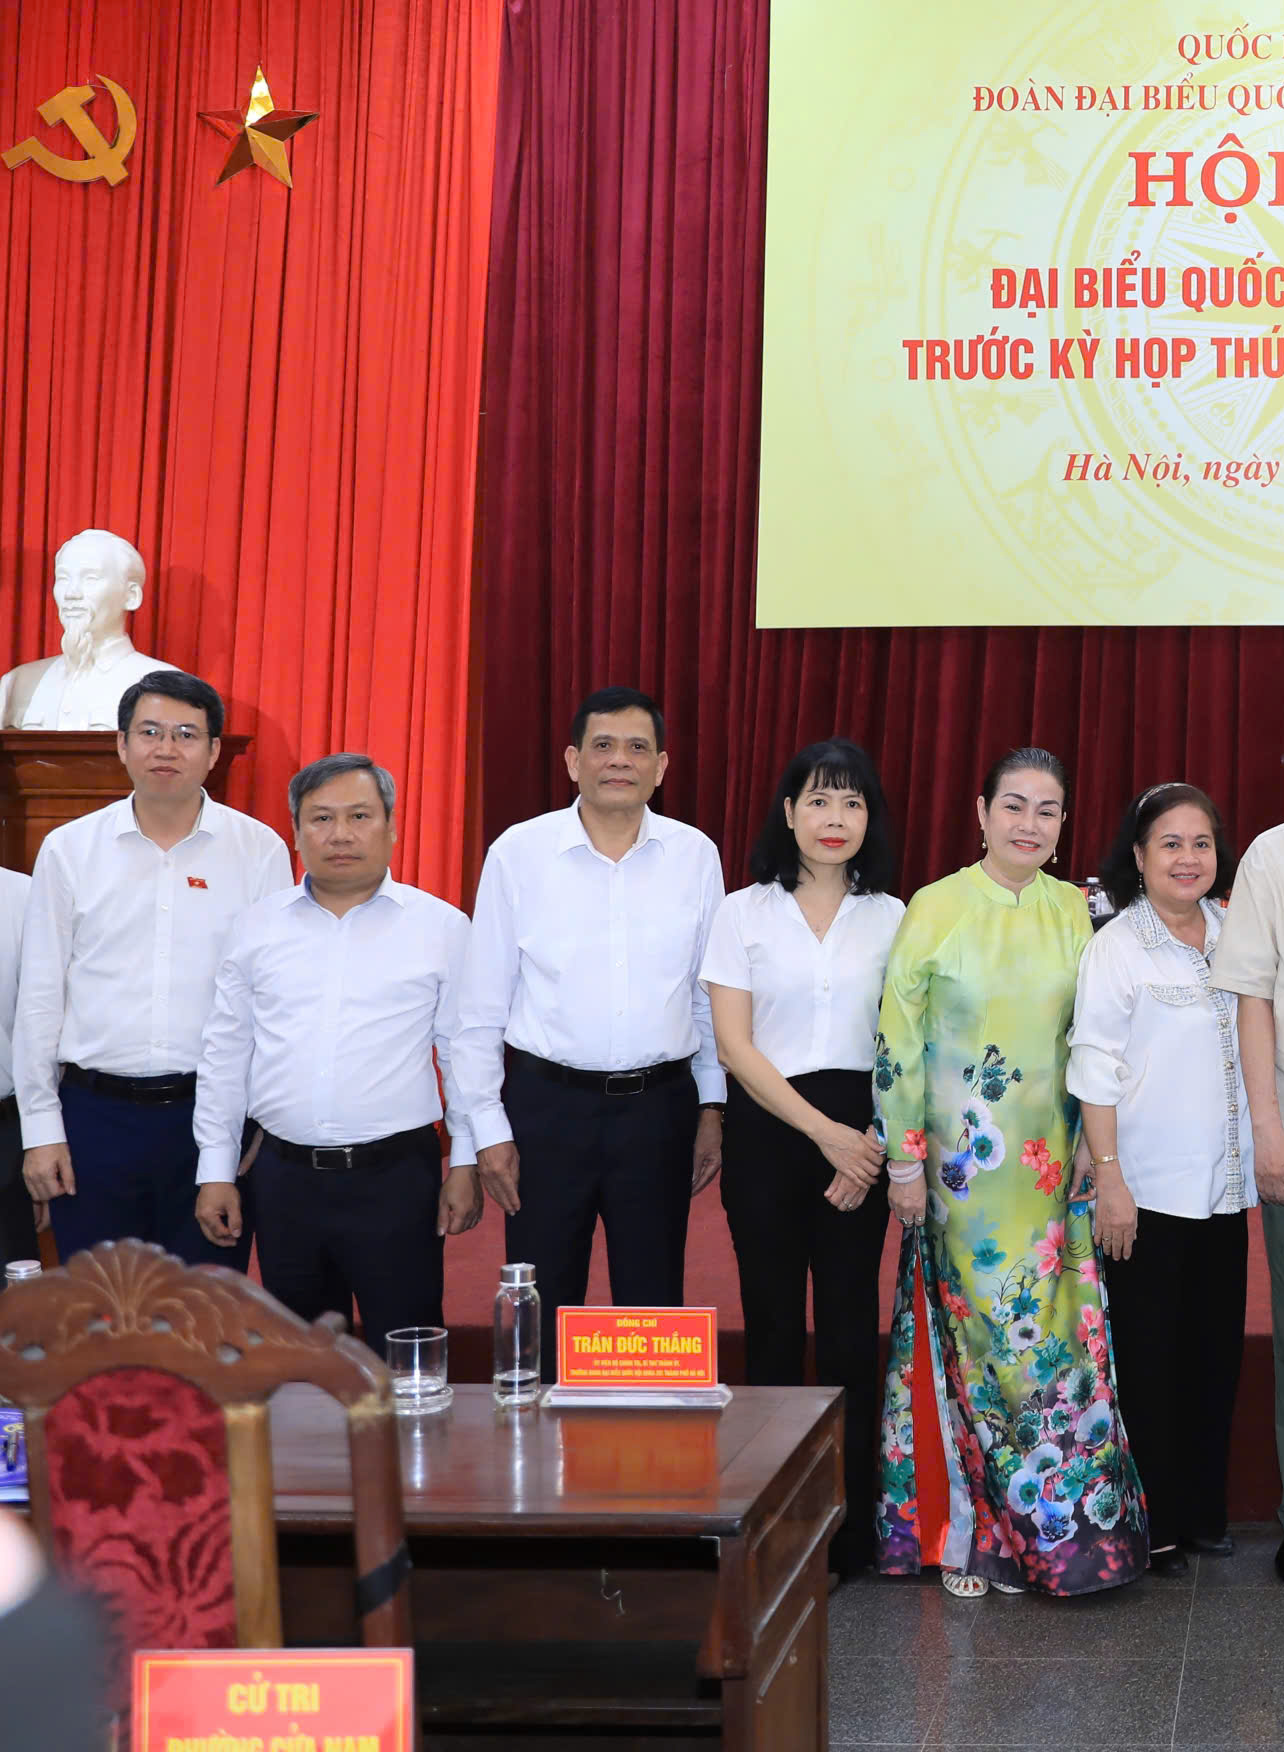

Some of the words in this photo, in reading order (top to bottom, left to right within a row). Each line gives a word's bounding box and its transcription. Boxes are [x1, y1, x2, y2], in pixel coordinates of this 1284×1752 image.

[1178, 24, 1272, 65] QUỐC
[973, 78, 1065, 112] ĐOÀN
[1075, 85, 1132, 117] ĐẠI
[1142, 72, 1218, 111] BIỂU
[990, 267, 1059, 319] ĐẠI
[1073, 249, 1167, 309] BIỂU
[902, 325, 1035, 381] TRƯỚC
[1049, 328, 1101, 380] KỲ
[1115, 337, 1197, 389] HỌP
[1063, 453, 1113, 481] Hà
[1122, 452, 1191, 488] Nội,
[1203, 453, 1281, 488] ngày
[572, 1330, 613, 1353] TRẦN
[617, 1331, 648, 1353] ĐỨC
[651, 1331, 702, 1353] THẮNG
[227, 1671, 271, 1715] CỬ
[275, 1683, 320, 1713] TRI
